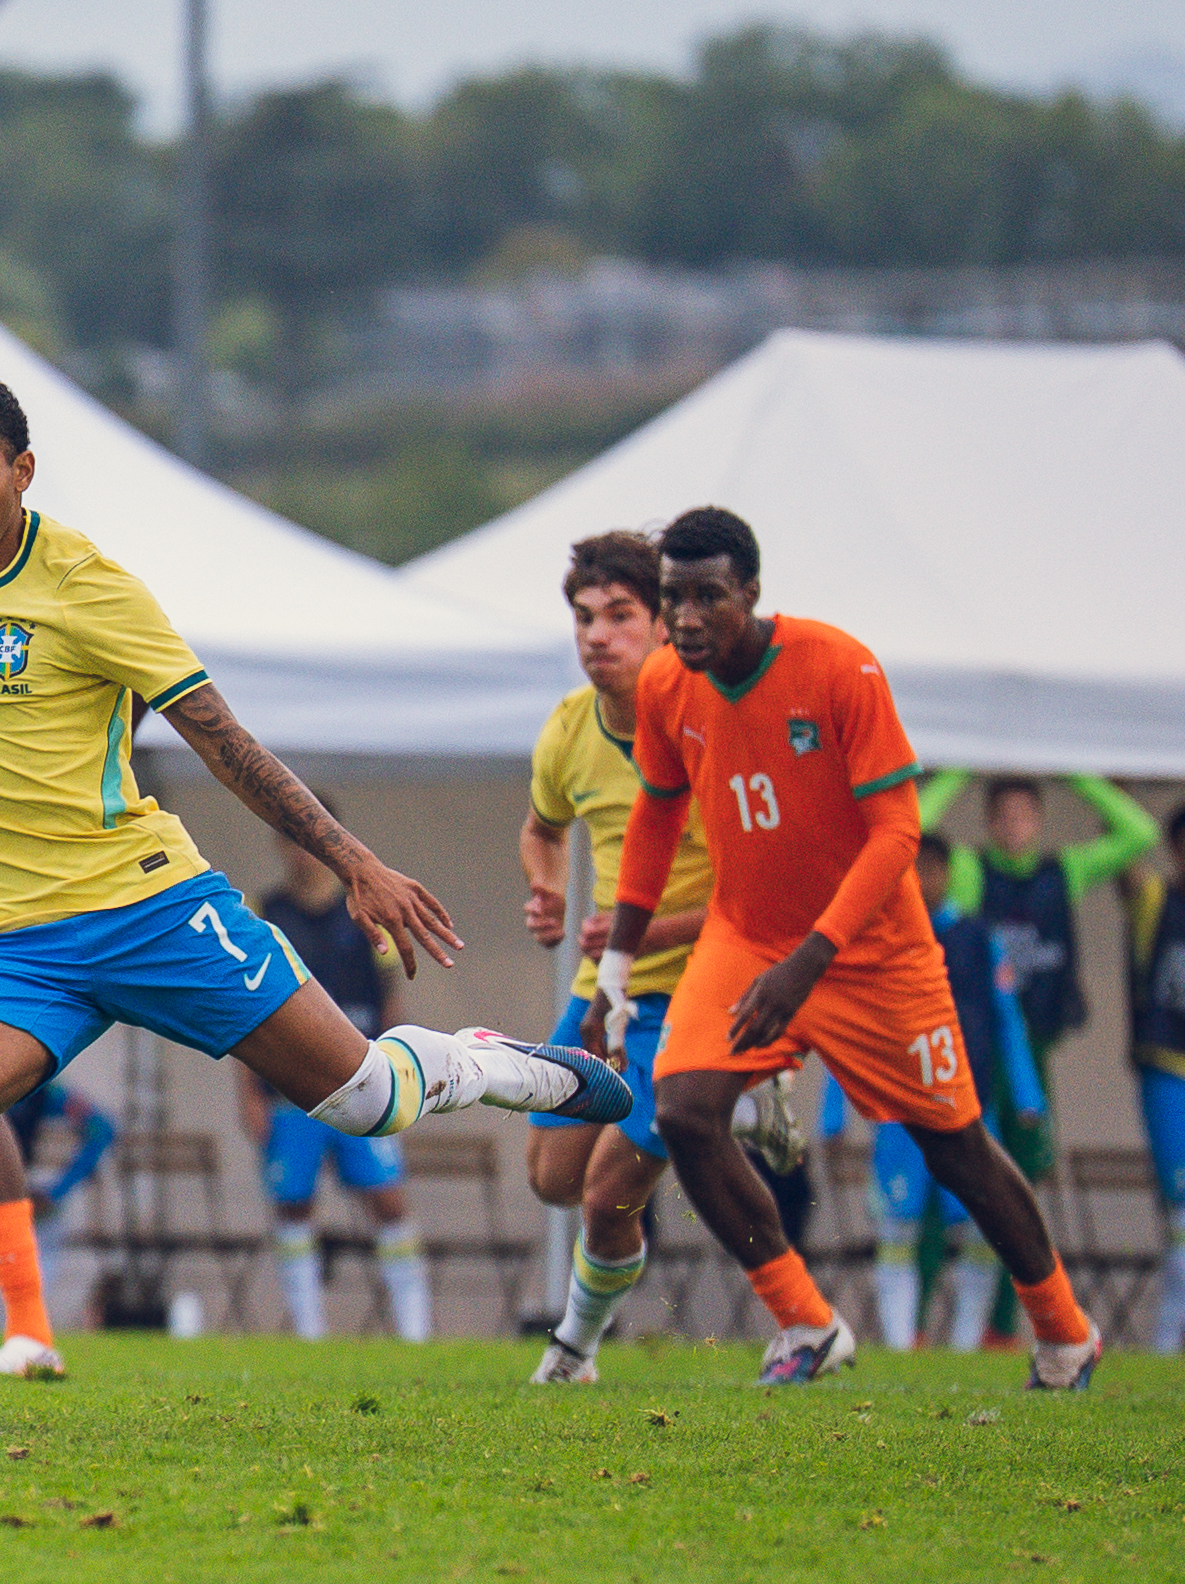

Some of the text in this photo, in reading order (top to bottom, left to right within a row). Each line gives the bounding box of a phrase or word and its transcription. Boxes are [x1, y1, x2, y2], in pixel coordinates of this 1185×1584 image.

[729, 772, 781, 832] 13
[188, 901, 247, 962] 7
[907, 1024, 958, 1087] 13
